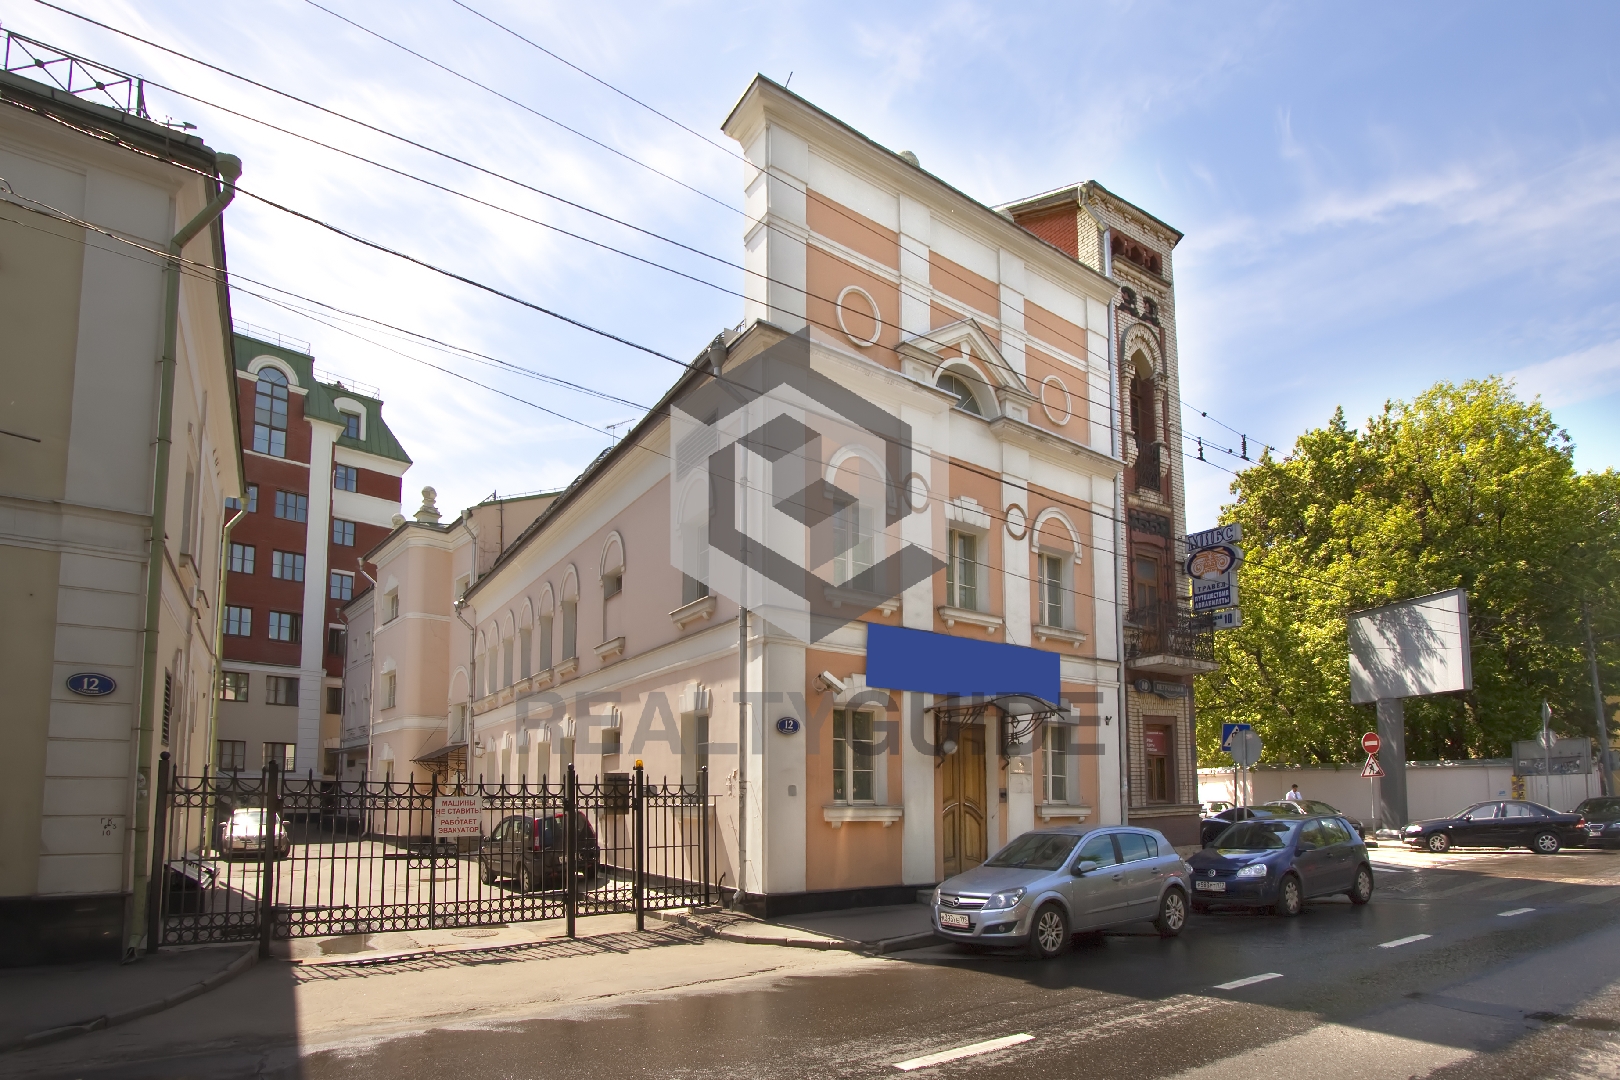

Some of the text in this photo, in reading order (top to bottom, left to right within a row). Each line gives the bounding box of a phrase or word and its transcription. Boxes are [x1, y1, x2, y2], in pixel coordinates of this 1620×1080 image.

[1188, 525, 1234, 551] МИБС
[1197, 581, 1226, 592] ТРАВЕЛ
[1224, 613, 1233, 624] 10
[82, 677, 99, 690] 12
[785, 720, 794, 729] 12
[447, 807, 482, 815] СТАВИТЬ!
[440, 818, 478, 826] РАБОТАЕТ
[438, 826, 479, 834] ЭВАКУАТОР
